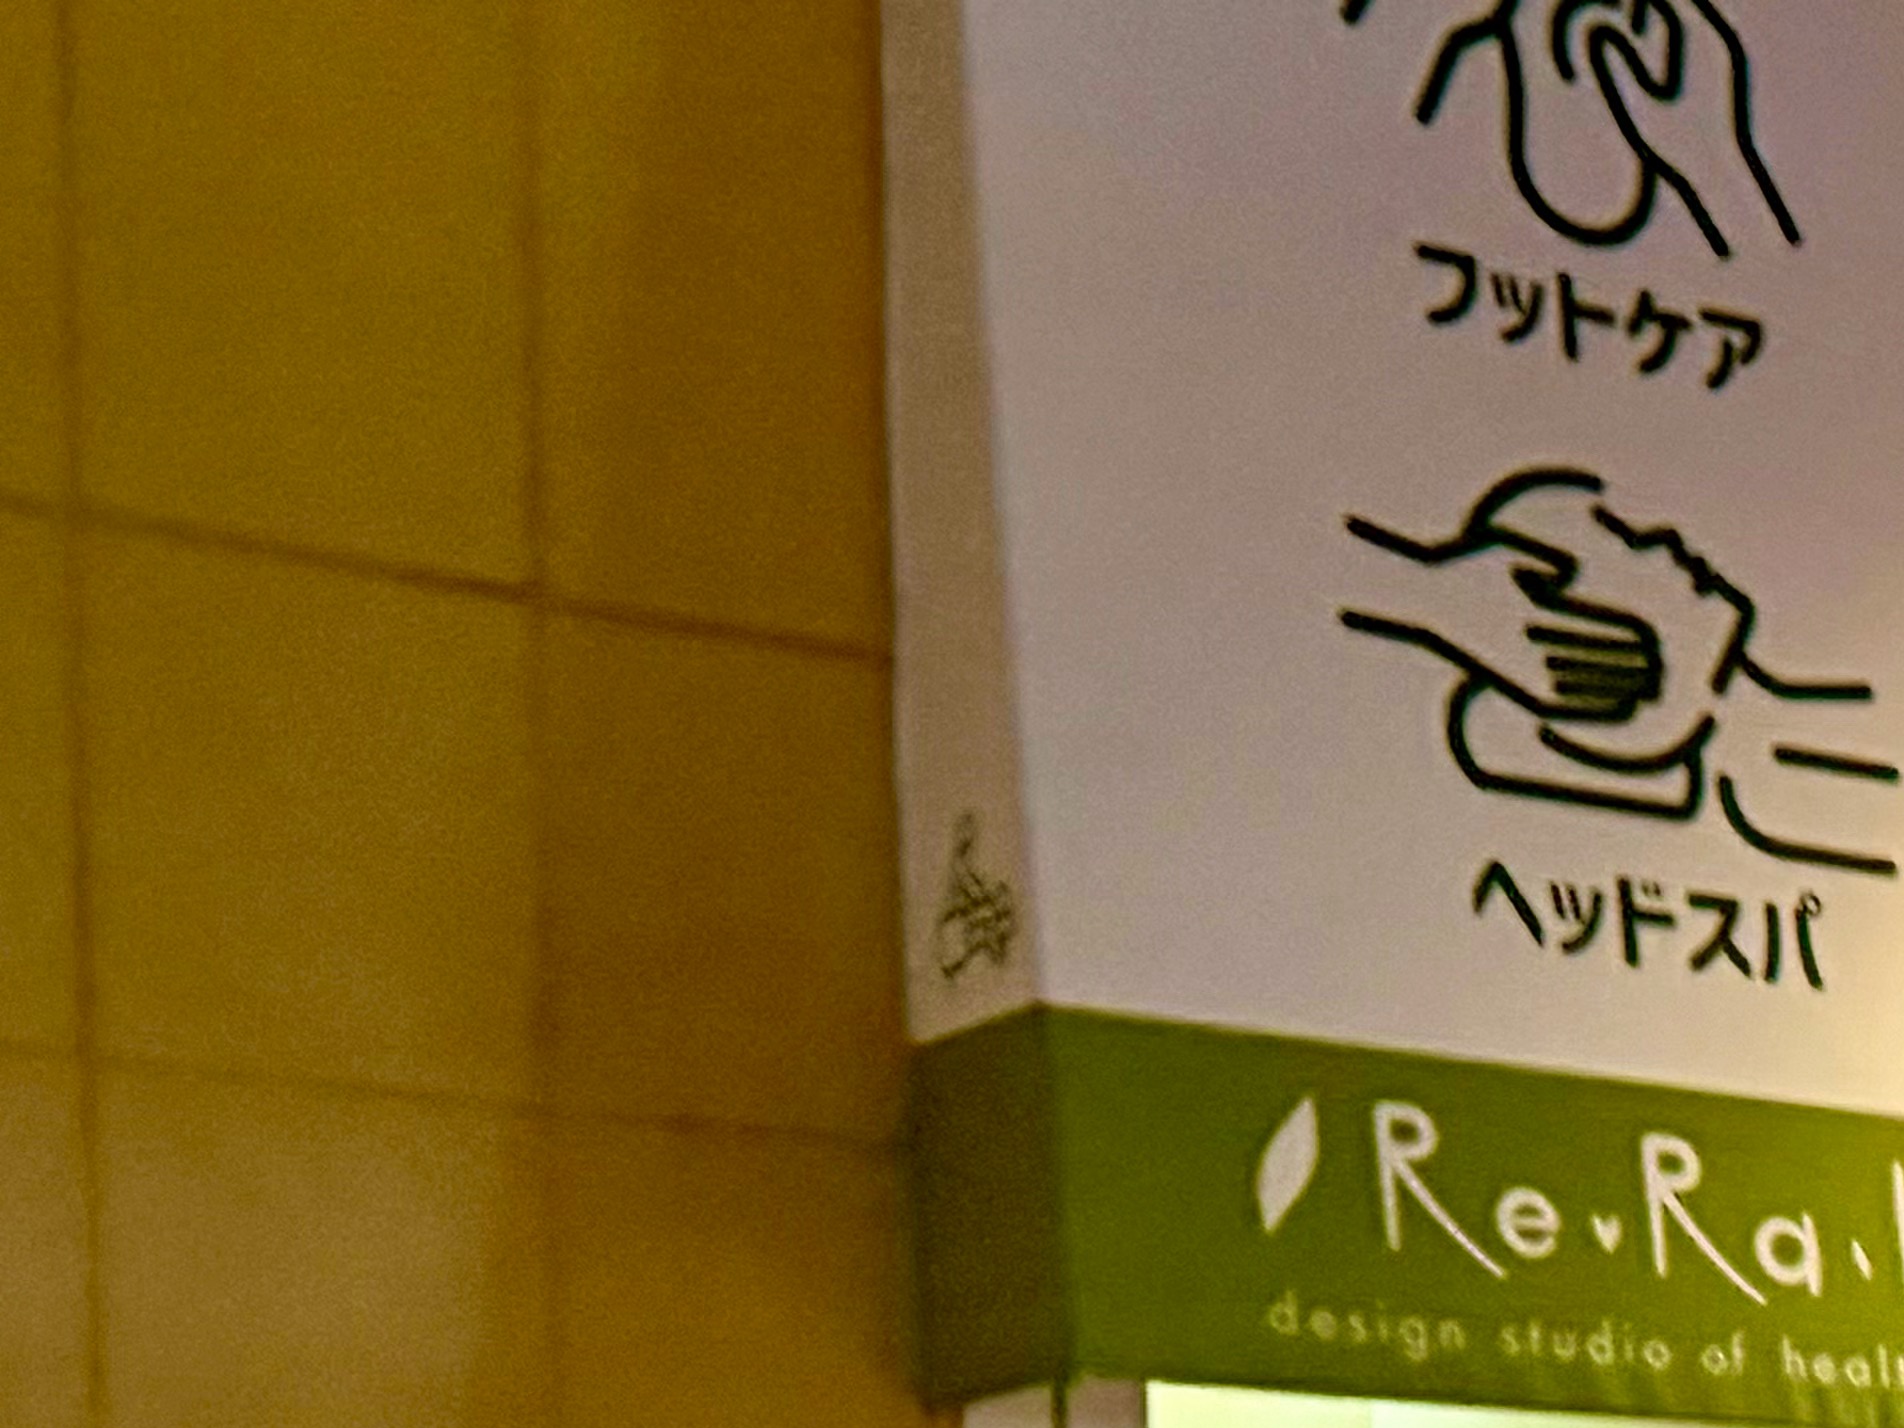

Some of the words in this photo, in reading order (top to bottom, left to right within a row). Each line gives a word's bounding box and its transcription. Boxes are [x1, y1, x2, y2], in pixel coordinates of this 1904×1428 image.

[1412, 243, 1765, 393] フットケア
[1473, 861, 1825, 990] ヘッドスパ
[1267, 1291, 1466, 1359] design
[1500, 1314, 1673, 1373] studio
[1702, 1330, 1747, 1376] of
